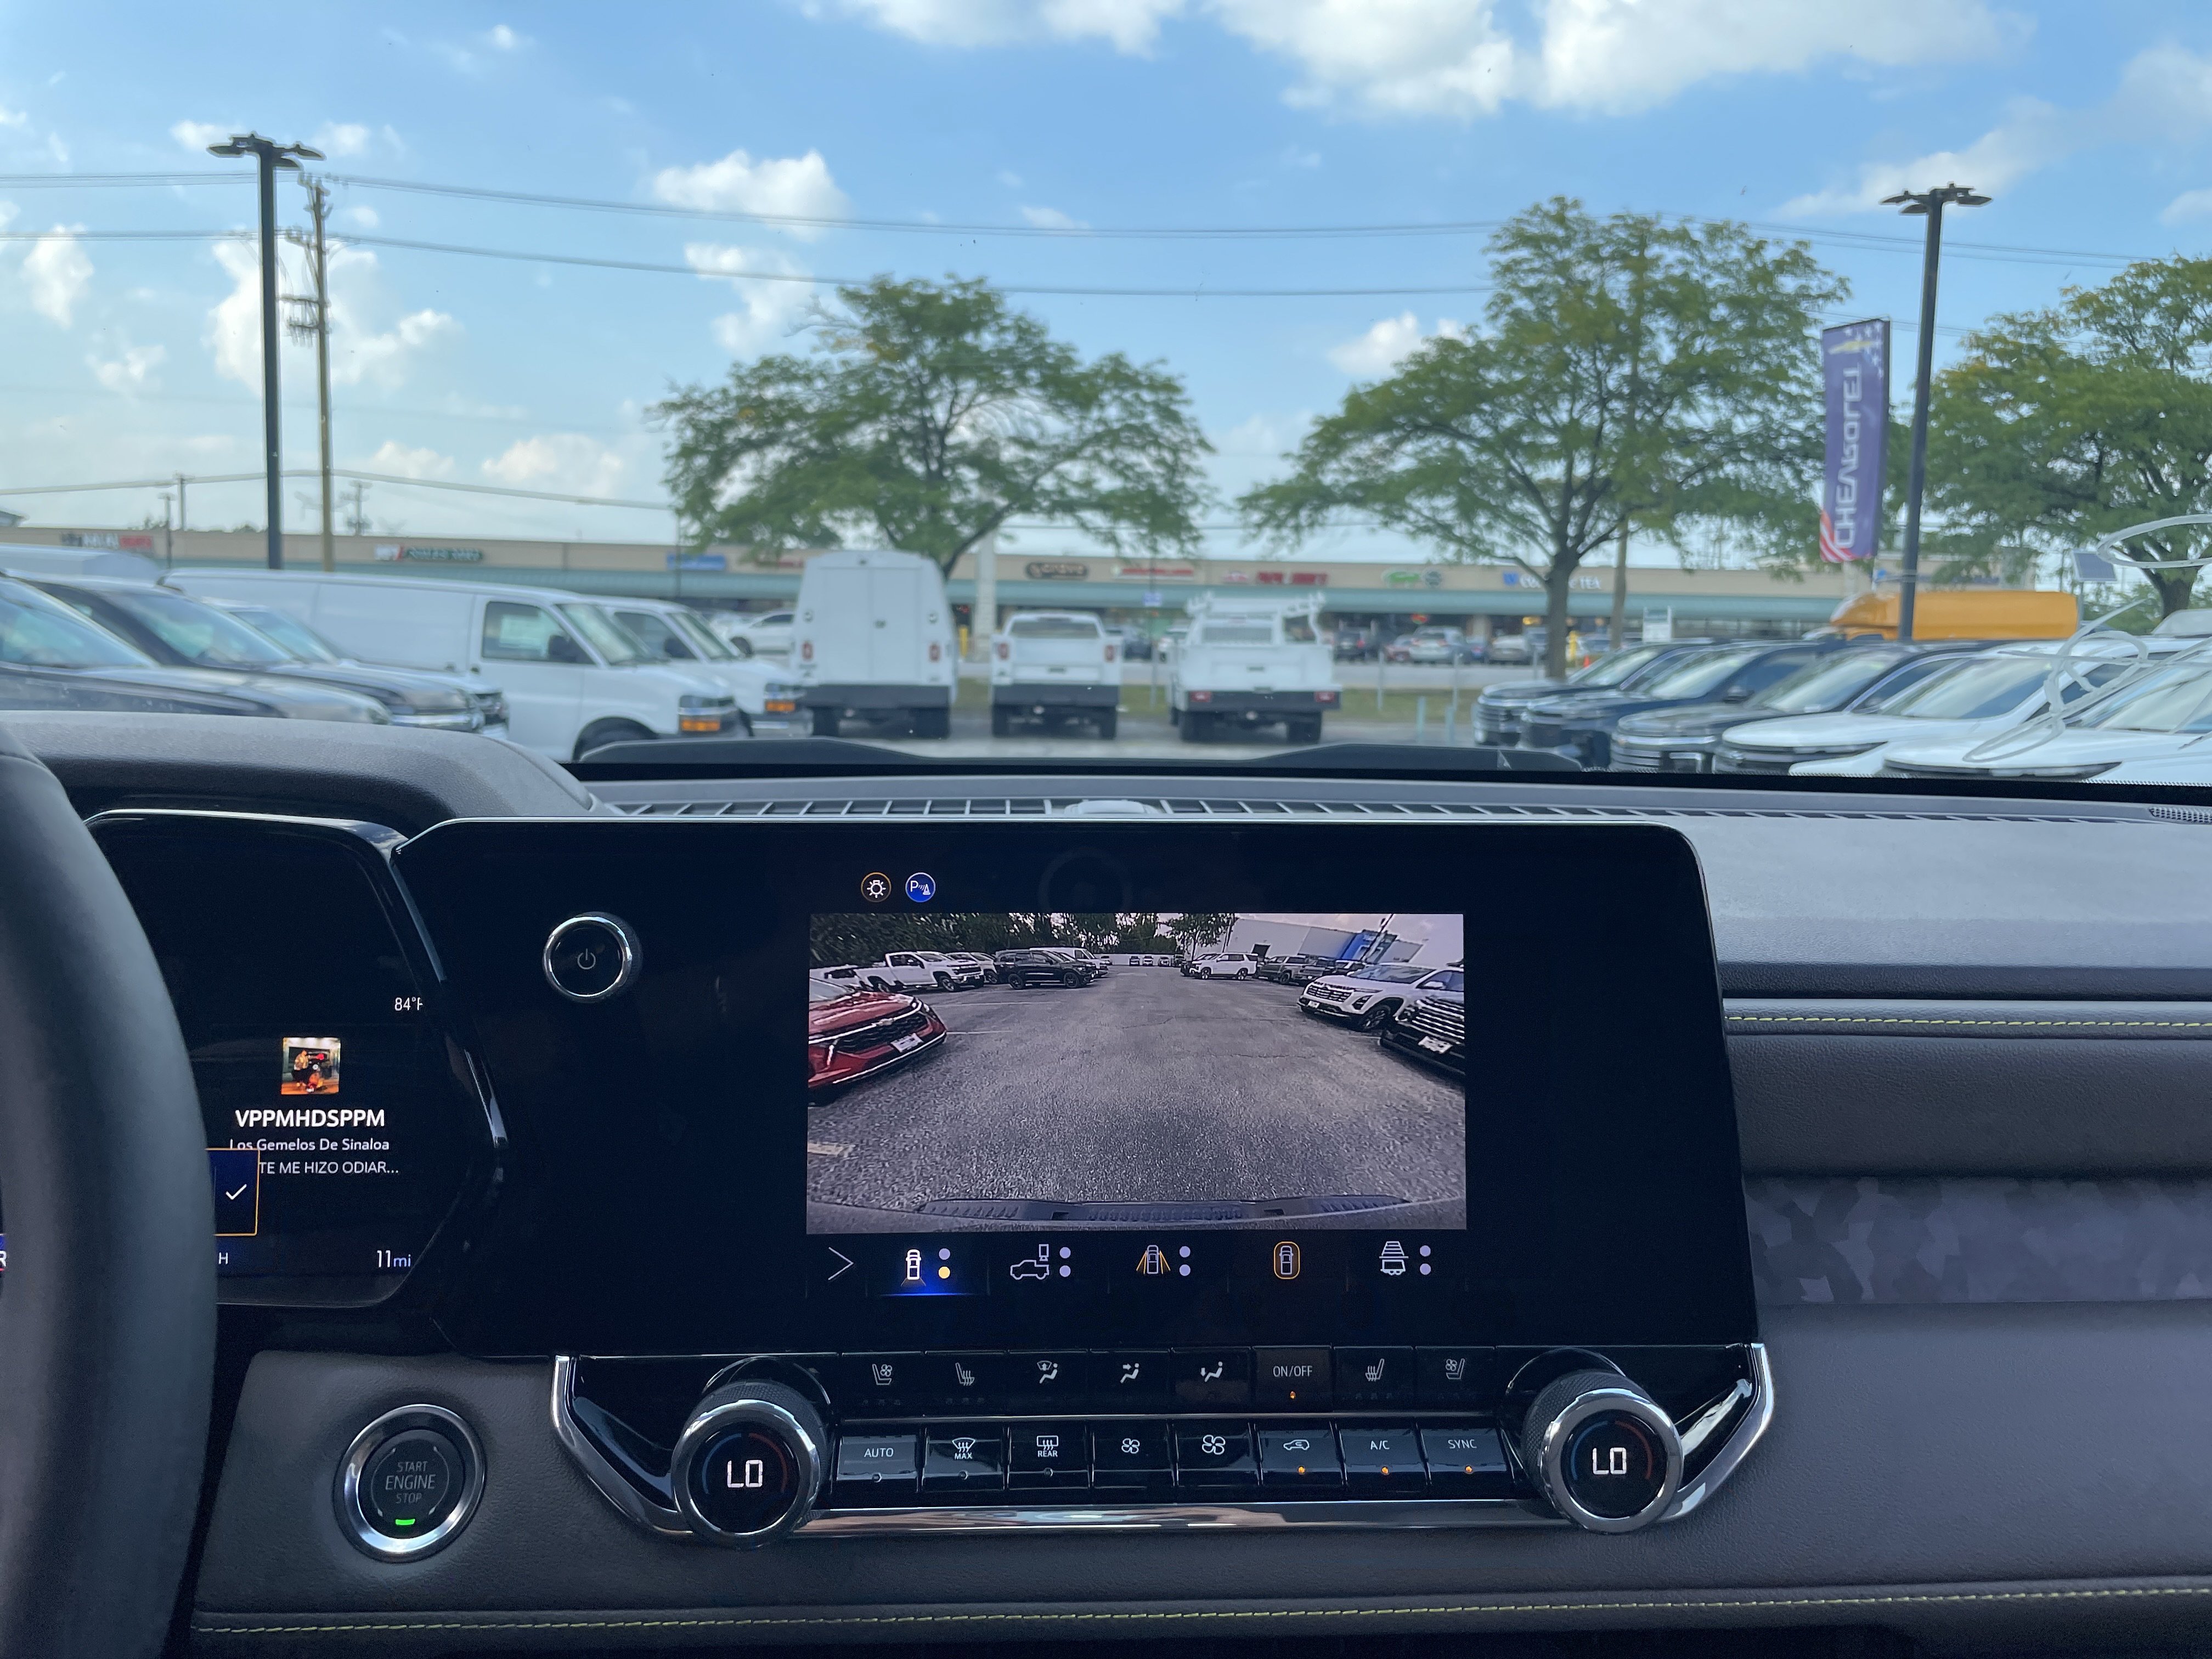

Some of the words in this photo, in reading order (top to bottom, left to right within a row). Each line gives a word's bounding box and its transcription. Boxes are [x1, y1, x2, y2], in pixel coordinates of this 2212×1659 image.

[235, 1109, 385, 1127] VPPMHDSPPM
[256, 1138, 315, 1150] Gemelos
[320, 1138, 338, 1150] De
[342, 1138, 390, 1150] Sinaloa
[279, 1162, 301, 1174] ME
[304, 1161, 338, 1174] HIZO
[342, 1161, 399, 1174] ODIAR...
[1273, 1365, 1313, 1377] ON/OFF
[1370, 1441, 1390, 1450] A/C
[1448, 1439, 1477, 1449] SYNC
[864, 1447, 894, 1458] AUTO
[396, 1461, 427, 1472] START
[1592, 1447, 1627, 1475] LO
[727, 1459, 763, 1488] LO
[385, 1474, 436, 1490] ENGINE
[395, 1492, 422, 1504] STOP
